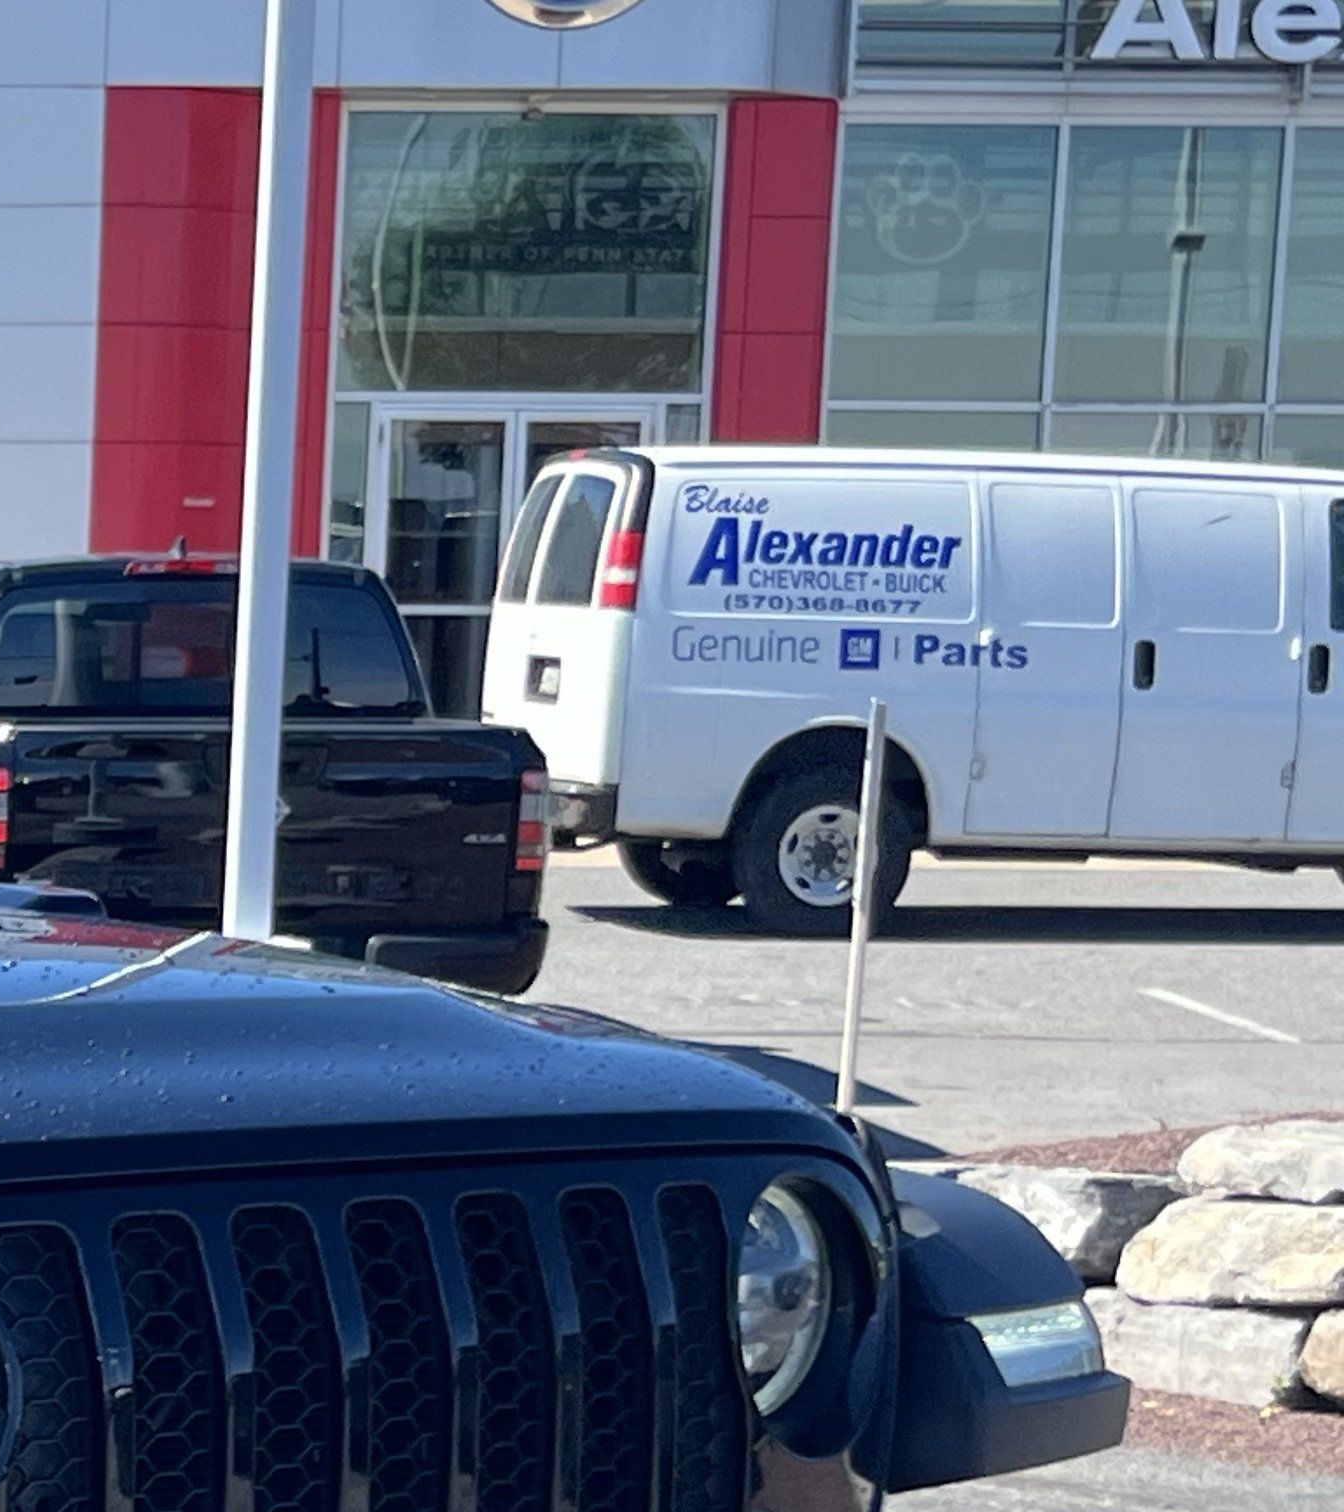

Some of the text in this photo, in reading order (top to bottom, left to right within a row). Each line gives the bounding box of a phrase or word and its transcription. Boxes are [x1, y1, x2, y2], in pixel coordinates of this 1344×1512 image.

[1090, 0, 1344, 64] Ale
[683, 484, 770, 515] Blaise
[687, 516, 962, 587] Alexander
[748, 568, 947, 594] CHEVROLET BUICK
[723, 594, 922, 615] (570)368-8677
[671, 625, 821, 664] Genuine
[913, 633, 1029, 669] Parts
